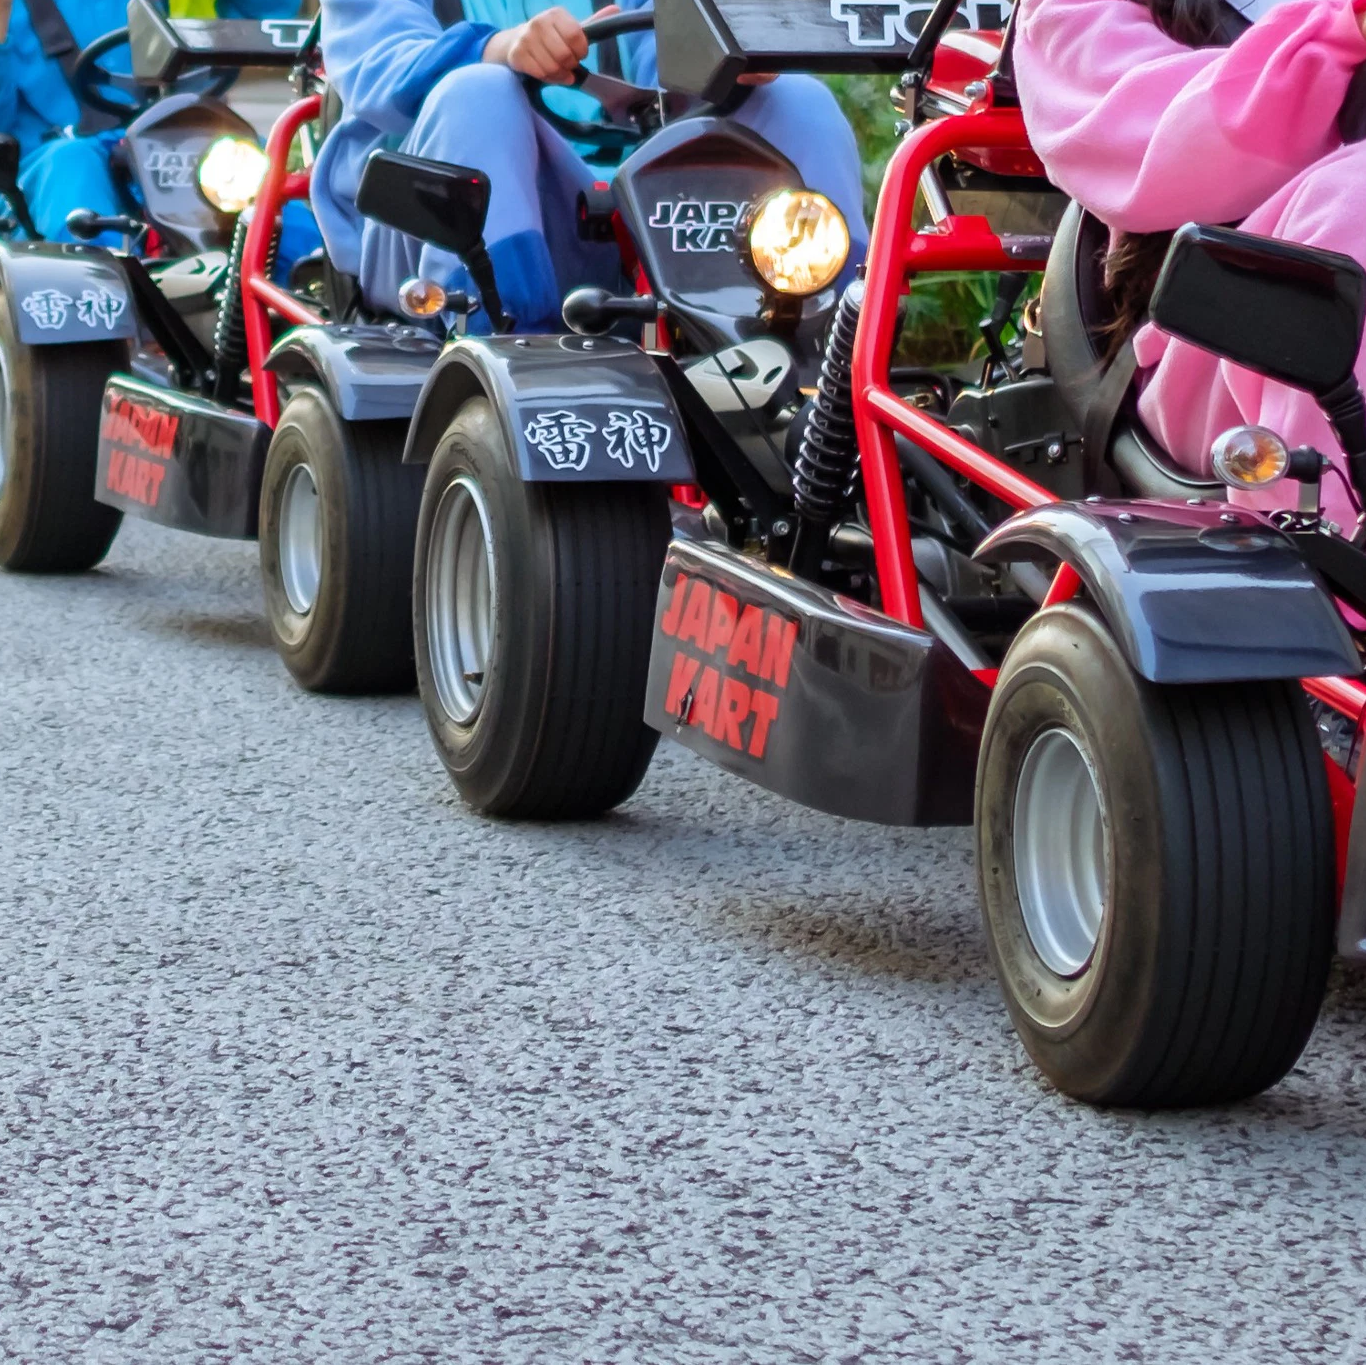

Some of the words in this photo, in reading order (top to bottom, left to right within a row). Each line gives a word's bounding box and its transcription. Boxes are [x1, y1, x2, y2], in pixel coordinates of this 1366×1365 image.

[524, 410, 671, 473] 雷神
[662, 572, 799, 689] JAPAN
[665, 651, 779, 759] KART
